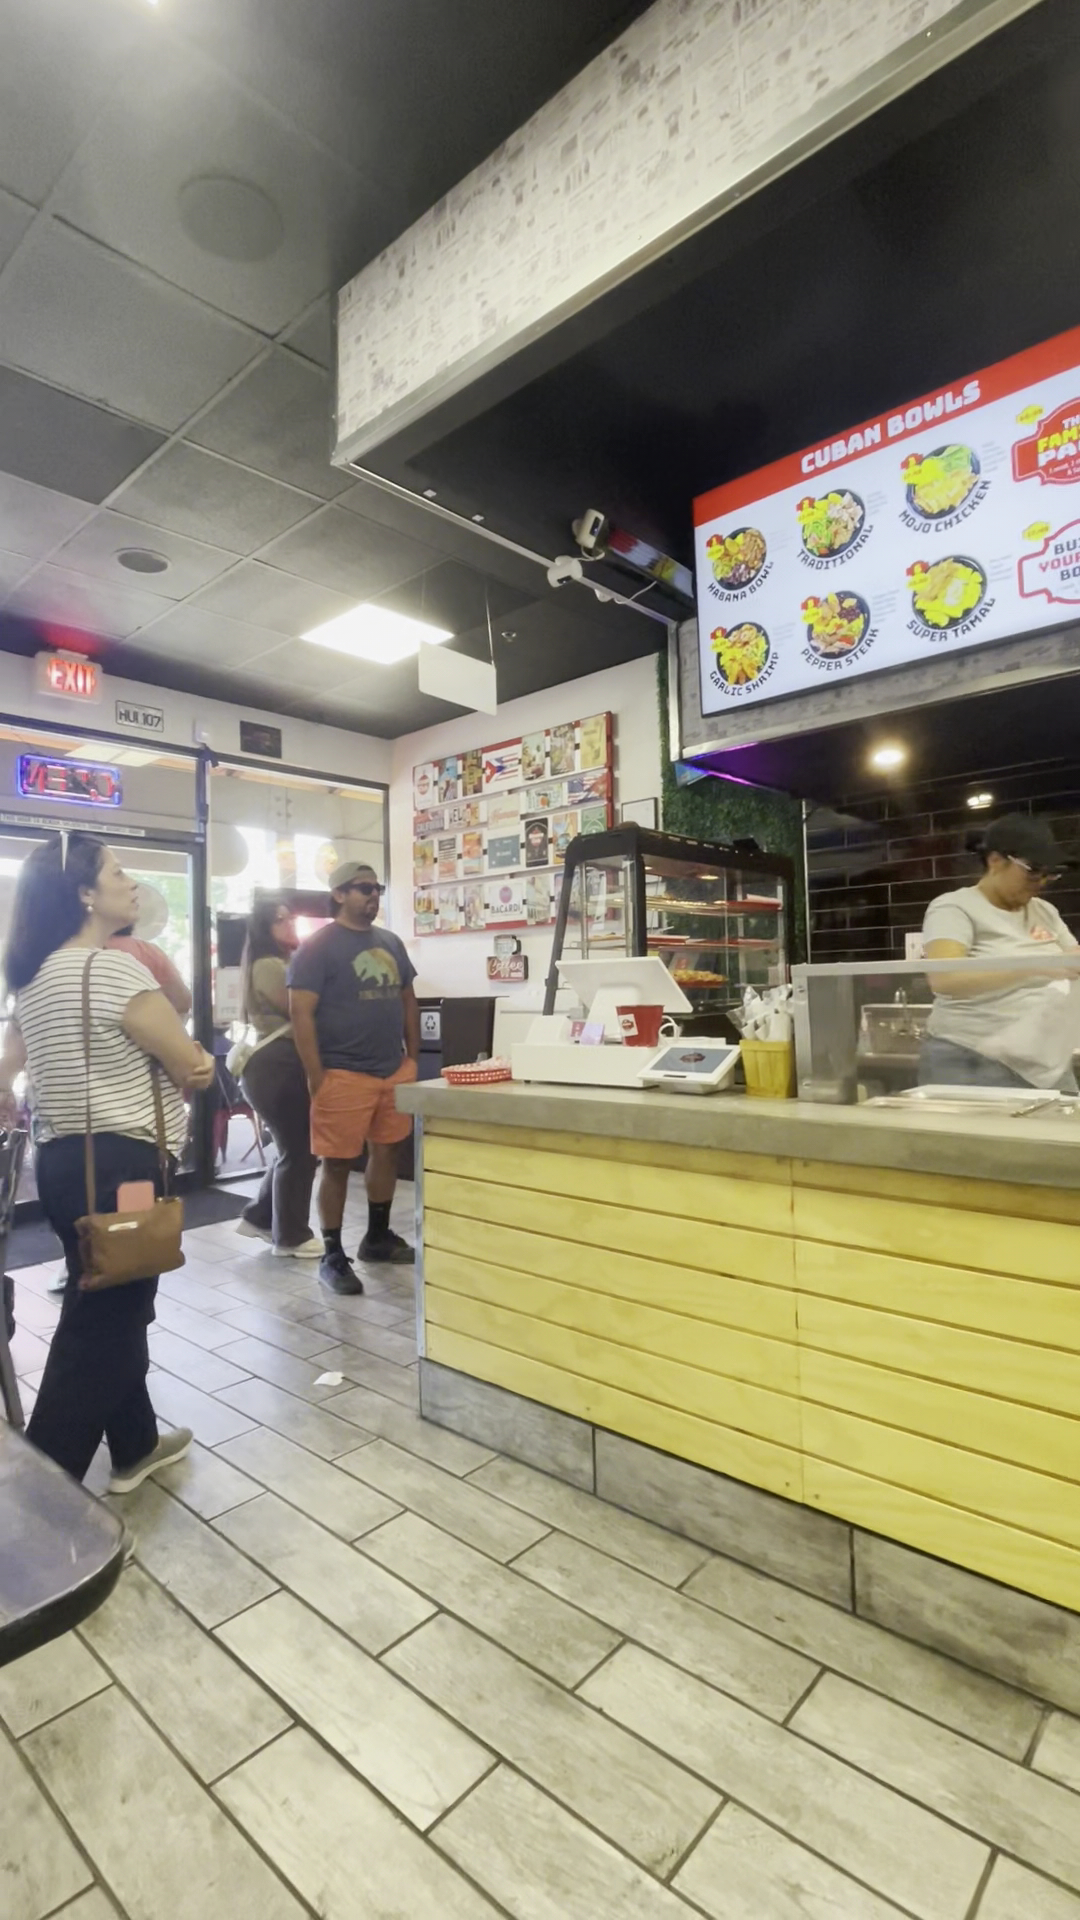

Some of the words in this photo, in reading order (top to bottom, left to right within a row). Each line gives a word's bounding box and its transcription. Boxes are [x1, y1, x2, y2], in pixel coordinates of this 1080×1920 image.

[801, 423, 881, 474] CUBAN
[887, 380, 980, 438] BOWLS
[1037, 426, 1080, 453] FAM
[1038, 441, 1080, 468] PA
[898, 509, 931, 534] MOJO
[935, 480, 991, 532] CHICKEN
[797, 523, 874, 570] TRADITIONAL
[707, 582, 747, 602] HABANA
[748, 561, 774, 594] BOWL
[906, 620, 948, 642] SUPER
[952, 598, 996, 638] TAMAL
[801, 648, 842, 671] PEPPER
[845, 628, 880, 666] STEAK
[50, 659, 95, 695] EXIT
[710, 670, 742, 696] GARLIC
[745, 652, 779, 694] SHRIMP
[142, 712, 161, 728] 107
[491, 903, 521, 914] BACARDI
[488, 958, 524, 976] Coffee
